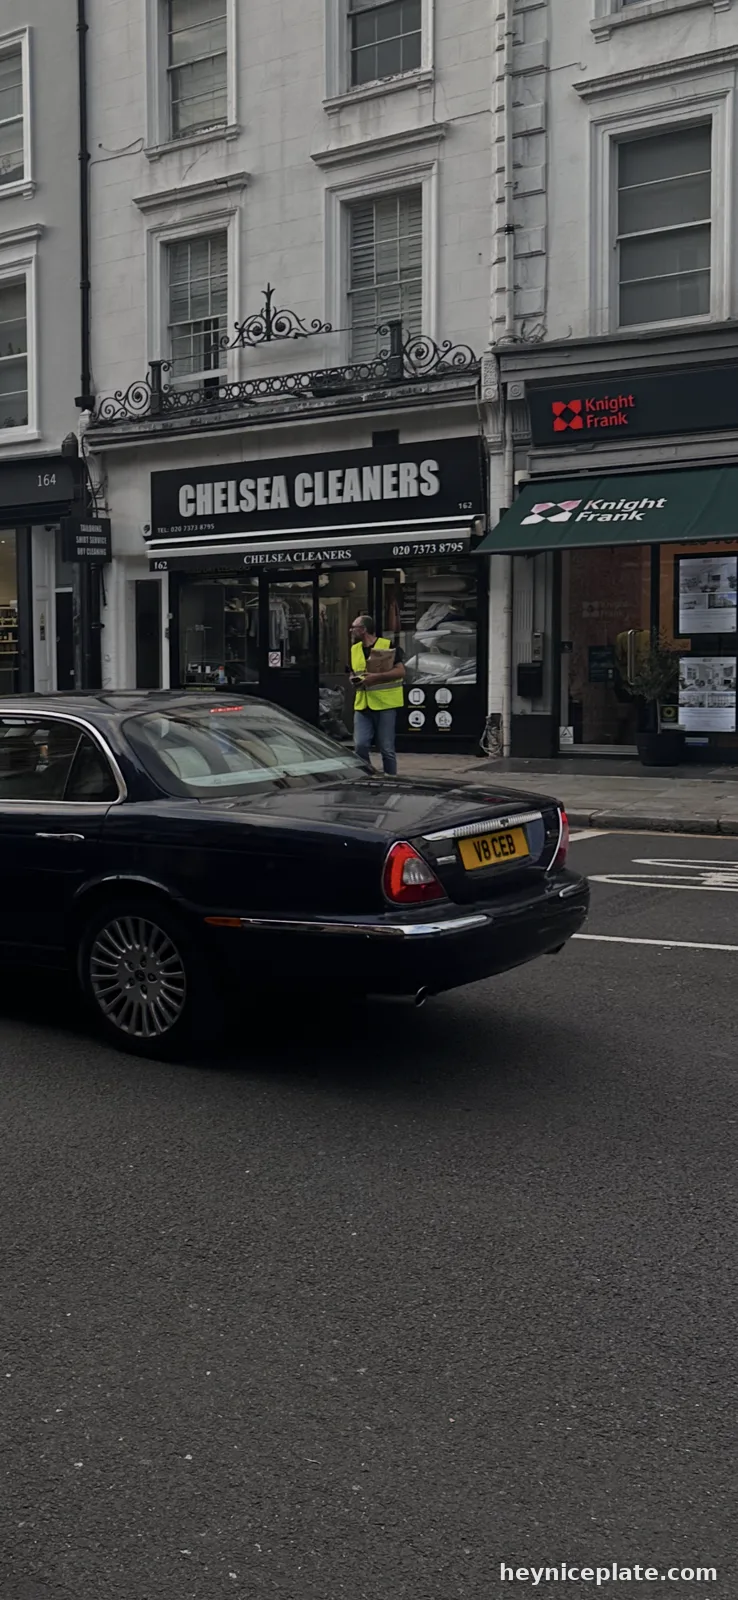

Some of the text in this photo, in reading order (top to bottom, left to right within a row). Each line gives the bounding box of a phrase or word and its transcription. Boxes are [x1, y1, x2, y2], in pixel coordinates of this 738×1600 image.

[585, 394, 635, 412] Knight
[586, 412, 628, 428] Frank
[37, 474, 56, 487] 164
[178, 459, 440, 518] CHELSEA CLEANERS
[458, 502, 473, 510] 162
[583, 497, 668, 511] Knight
[575, 511, 646, 522] Frank
[170, 525, 182, 533] 020
[89, 536, 107, 545] SERVICE
[86, 548, 107, 556] CLEANING
[392, 542, 464, 555] 020 7373 8795
[243, 549, 352, 565] CHELSEA CLEANERS
[154, 561, 168, 570] 162
[473, 840, 490, 862] V8
[491, 834, 516, 858] CEB
